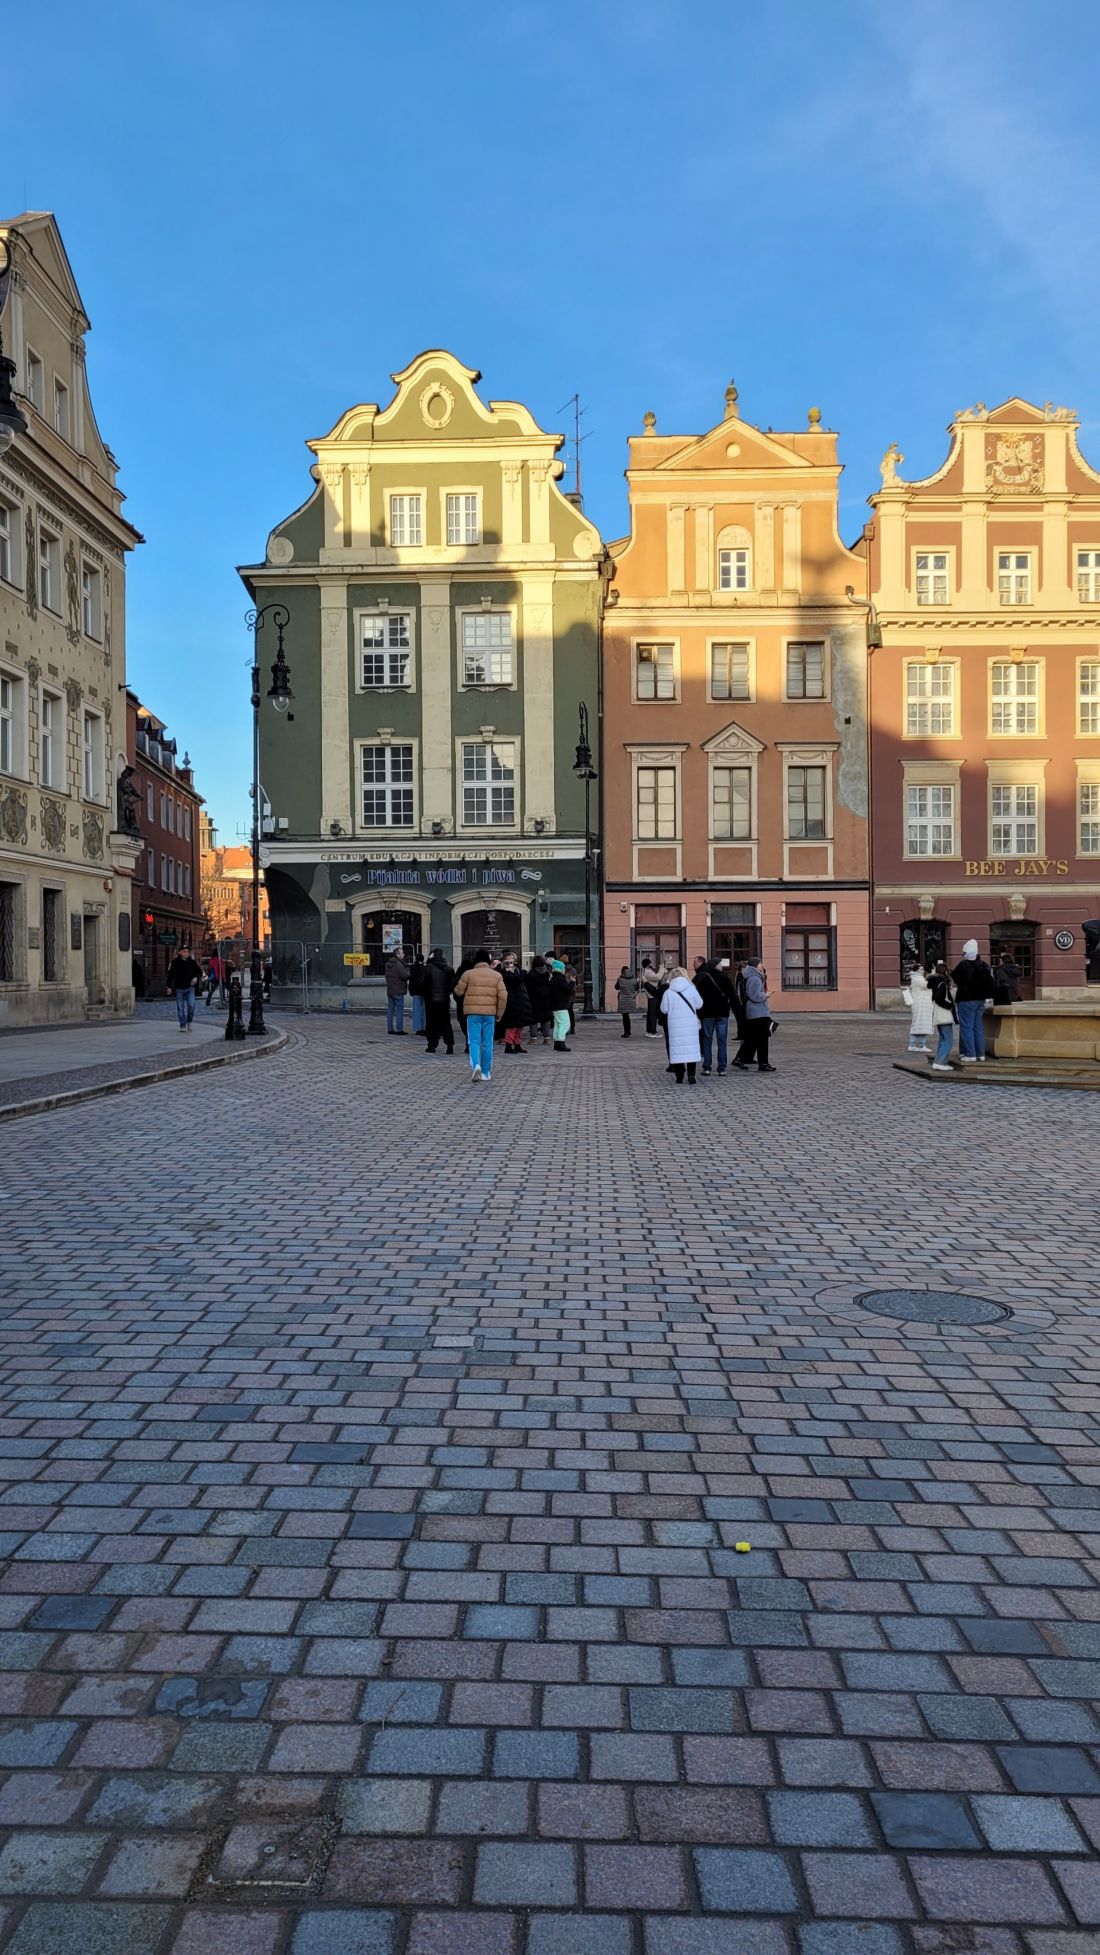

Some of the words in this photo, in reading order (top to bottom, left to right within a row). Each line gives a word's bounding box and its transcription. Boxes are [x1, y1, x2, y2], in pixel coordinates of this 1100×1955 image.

[370, 852, 416, 860] EDUKACJI
[486, 851, 555, 859] GOSPODARCZEJ
[964, 861, 1007, 876] BEE
[1014, 860, 1069, 876] JAY'S
[367, 869, 420, 885] Pijalnia
[426, 868, 467, 884] wódki
[472, 868, 477, 883] i
[483, 868, 515, 884] piwa
